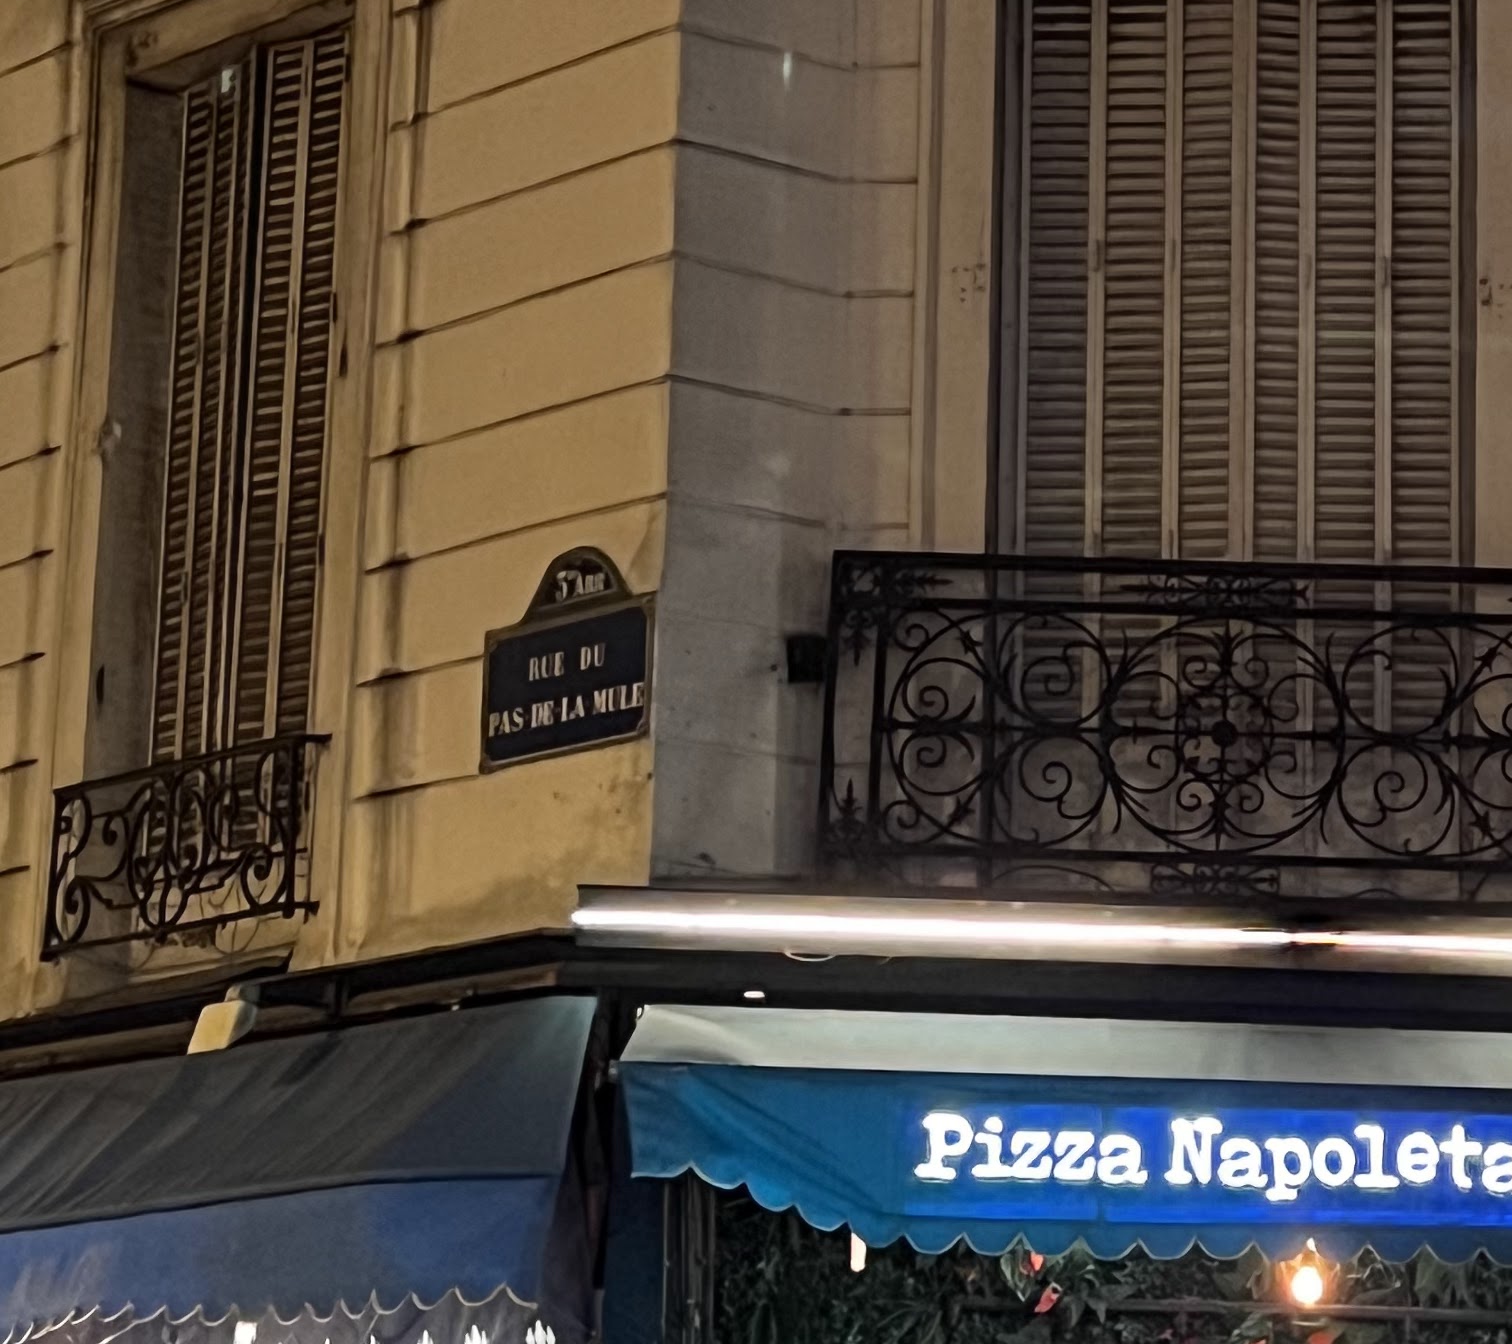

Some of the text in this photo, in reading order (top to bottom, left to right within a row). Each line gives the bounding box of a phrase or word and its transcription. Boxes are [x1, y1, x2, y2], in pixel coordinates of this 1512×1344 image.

[529, 643, 606, 682] RUE DU
[488, 682, 645, 737] PAS DE LA MULE
[913, 1110, 1149, 1186] Pizza
